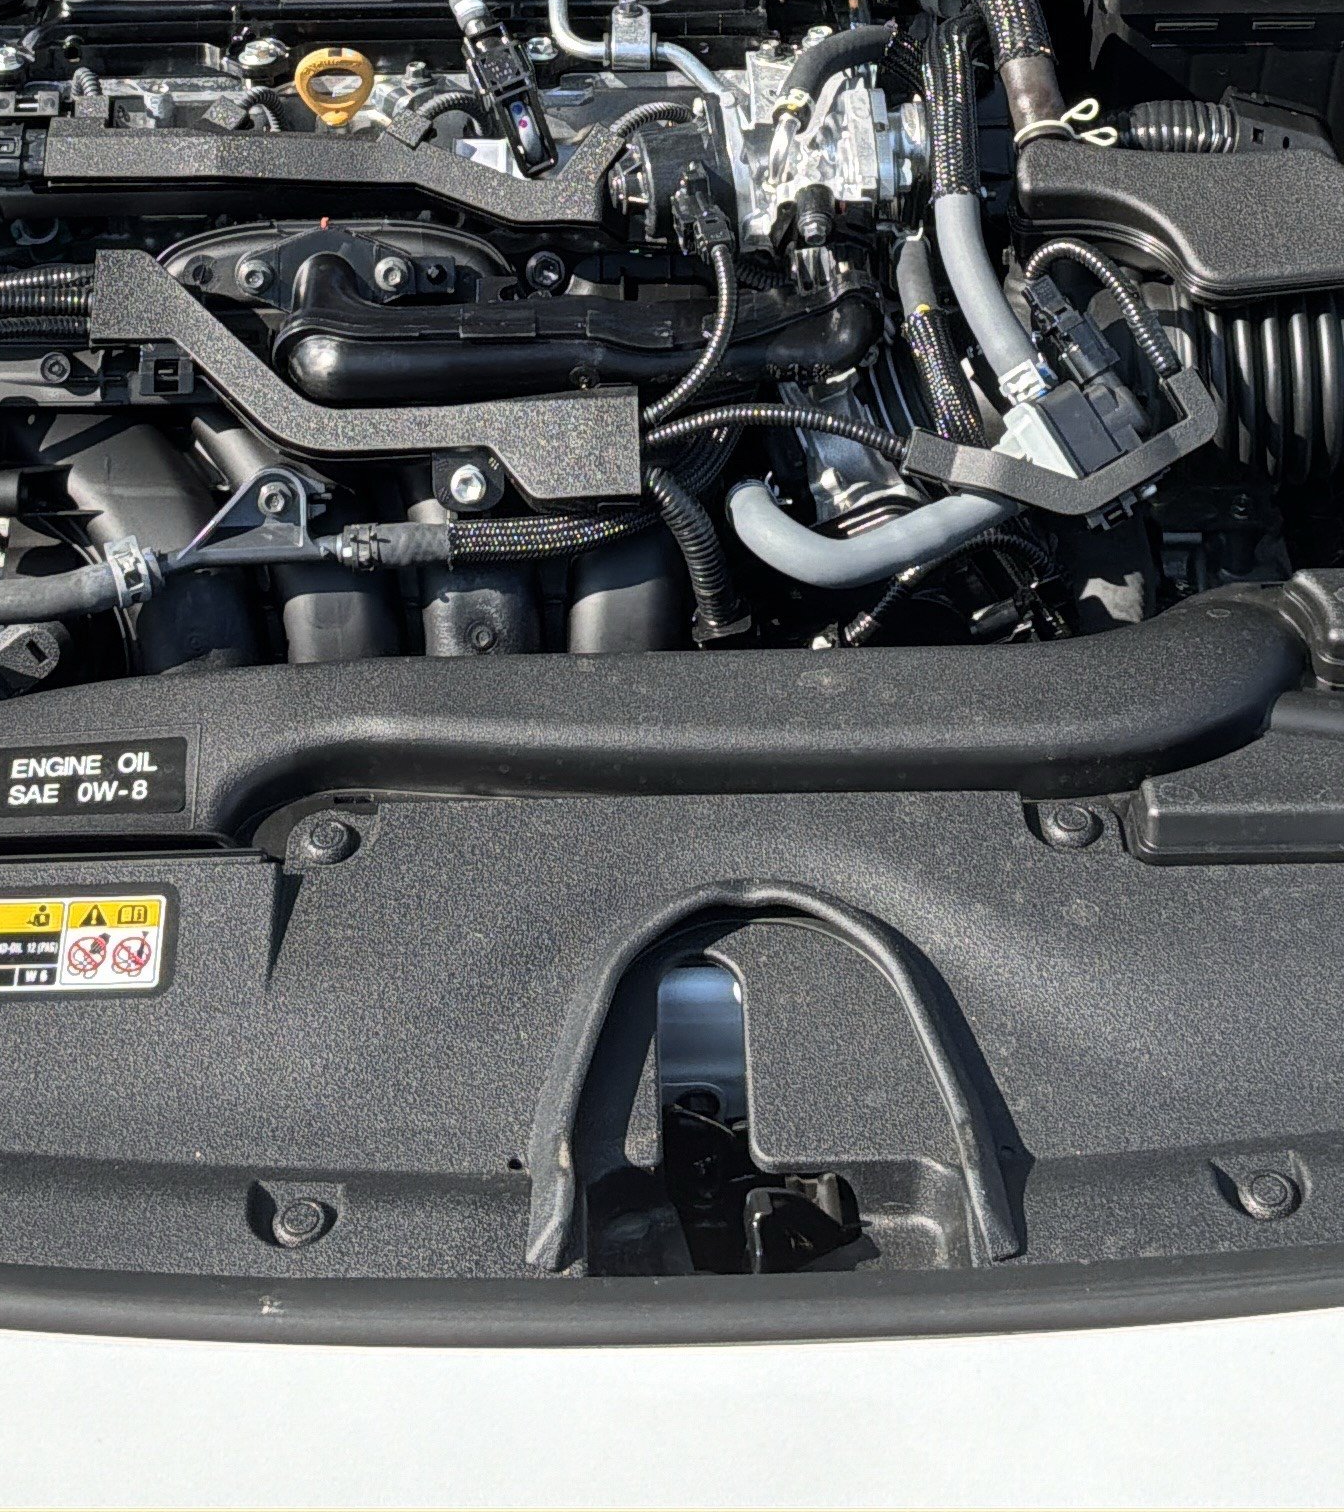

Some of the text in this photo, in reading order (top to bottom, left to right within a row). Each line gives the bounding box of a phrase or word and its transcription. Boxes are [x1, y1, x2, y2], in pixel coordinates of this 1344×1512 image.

[11, 751, 158, 778] ENGINE OIL
[8, 780, 147, 805] SAE 0W-8
